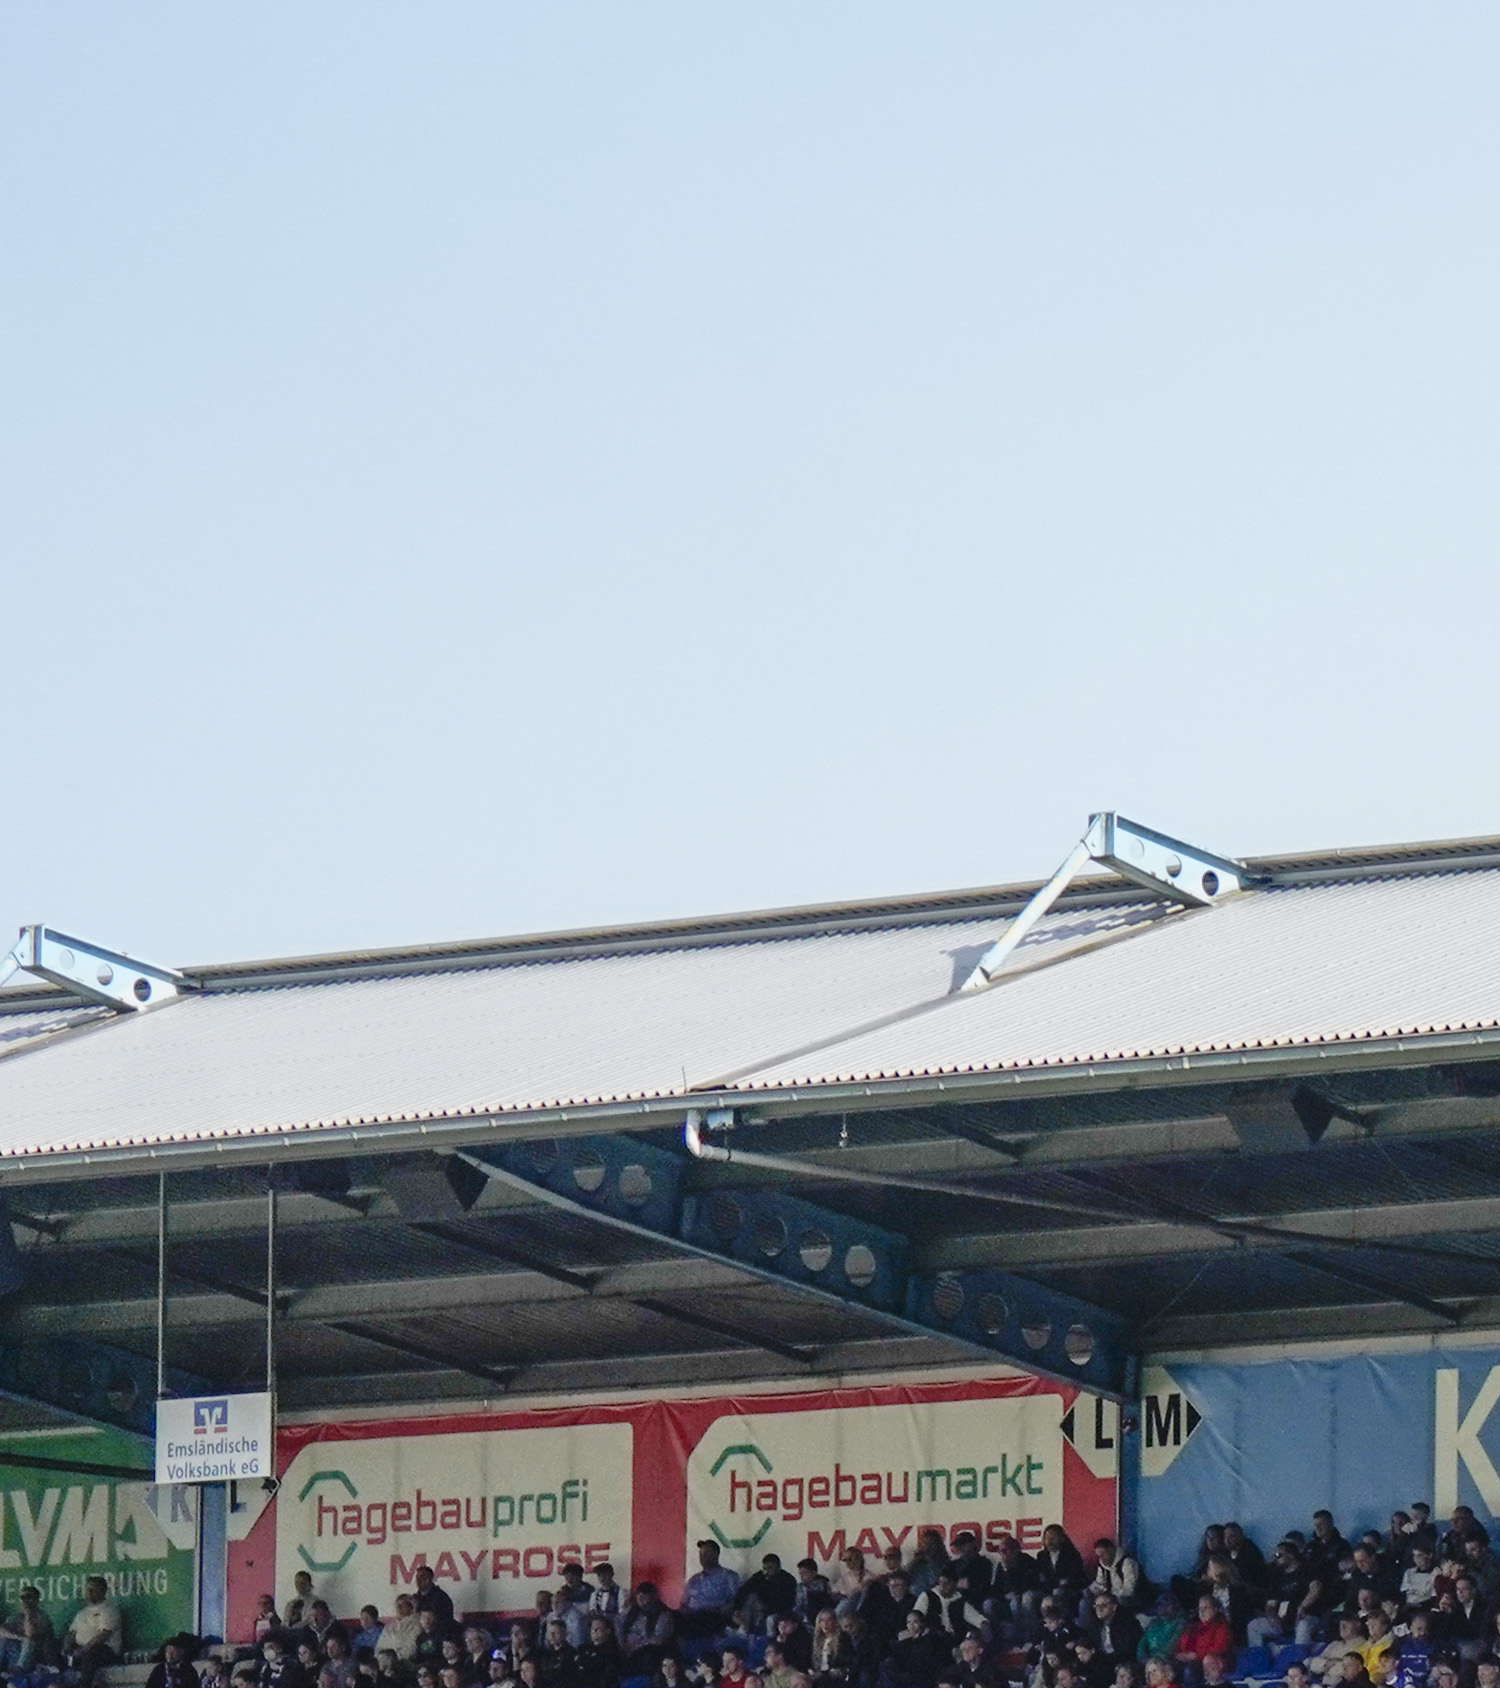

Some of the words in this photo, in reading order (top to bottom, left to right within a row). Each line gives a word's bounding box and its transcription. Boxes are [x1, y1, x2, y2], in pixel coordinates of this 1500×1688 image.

[1096, 1398, 1114, 1450] L
[1146, 1394, 1182, 1449] M
[167, 1437, 259, 1459] Emsländische
[167, 1459, 236, 1480] Volksbank
[241, 1459, 260, 1475] eG
[317, 1478, 589, 1545] hagebauprofi
[730, 1454, 1043, 1520] hagebaumarkt
[390, 1542, 612, 1587] MAYROSE
